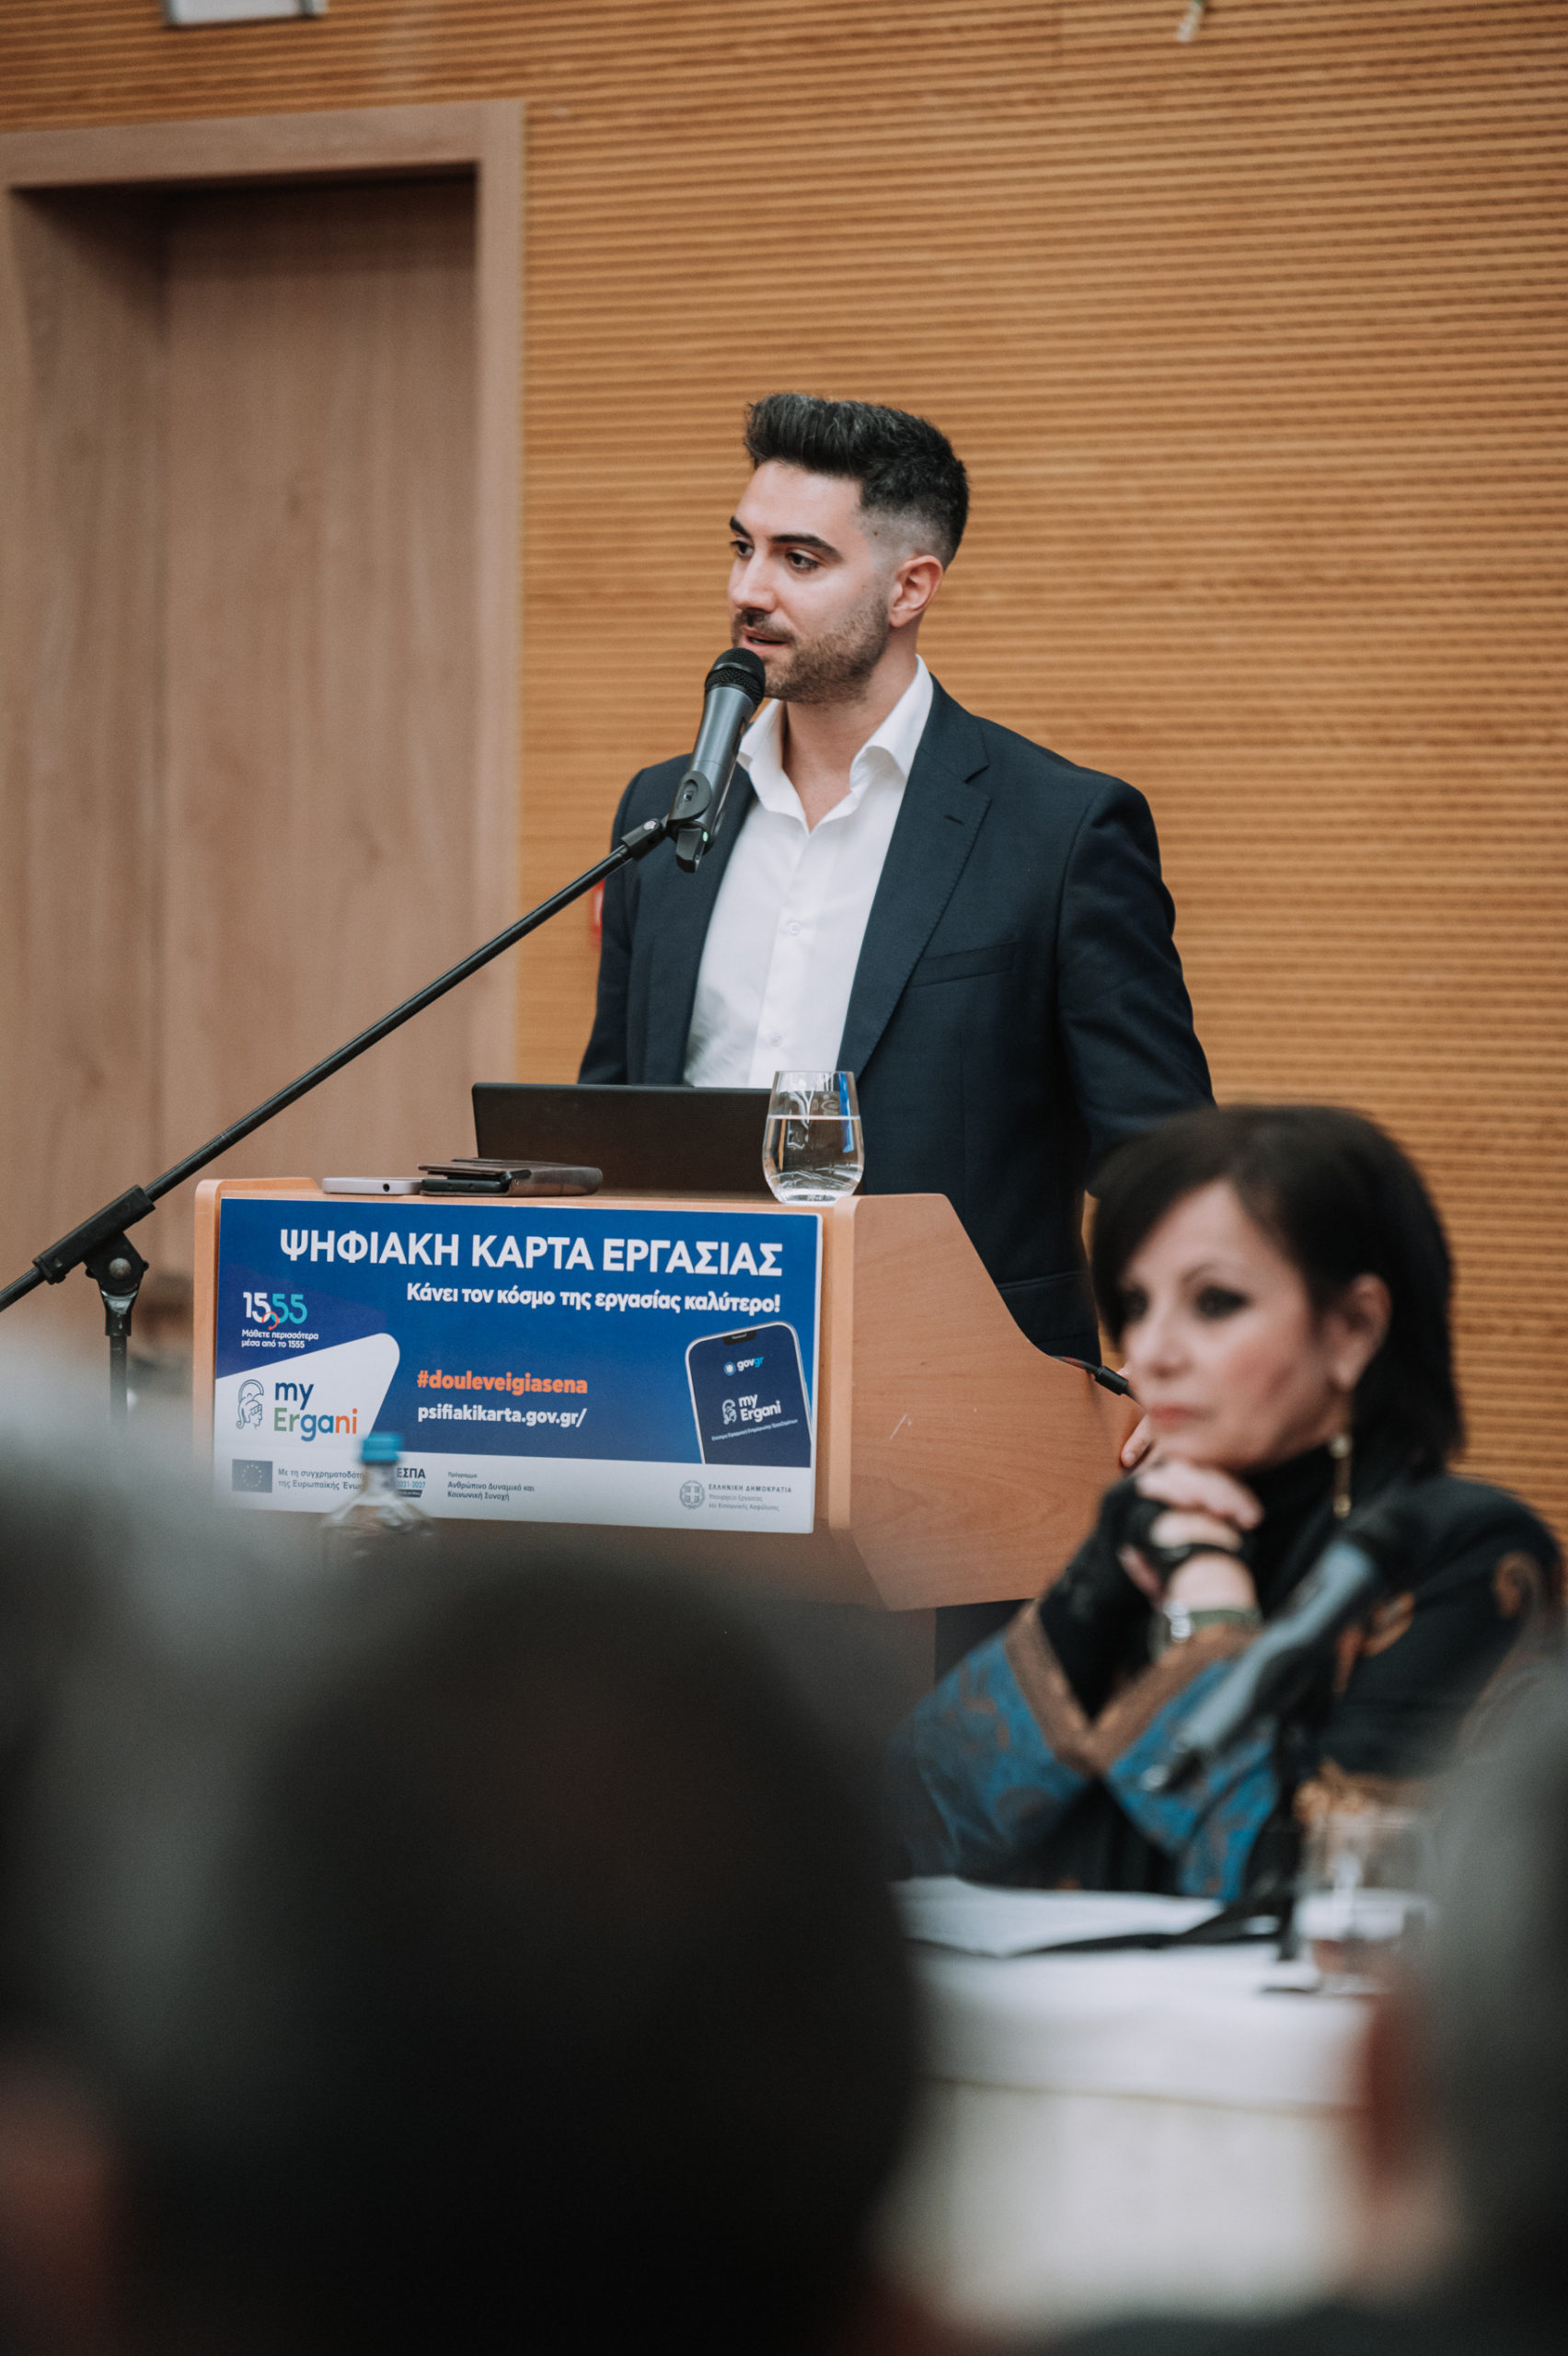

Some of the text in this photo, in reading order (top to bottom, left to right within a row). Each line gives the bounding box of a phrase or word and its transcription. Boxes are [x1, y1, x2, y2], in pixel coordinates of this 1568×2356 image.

[281, 1229, 782, 1276] ΨΗΦΙΑΚΗ ΚΑΡΤΑ ΕΡΓΑΣΙΑΣ
[243, 1292, 307, 1324] 1555
[407, 1282, 780, 1316] Κάνει τον κόσμο της εργασίας καλύτερο!
[241, 1339, 259, 1347] μέσα
[261, 1340, 276, 1348] από
[288, 1340, 306, 1349] 1555
[242, 1329, 319, 1341] Μάθετε περισσότερα
[736, 1357, 765, 1371] govgr
[417, 1369, 588, 1396] #douleveigiasena
[275, 1382, 314, 1411] my
[739, 1394, 758, 1409] my
[418, 1403, 588, 1427] psifiakikarta.gov.gr/
[739, 1400, 782, 1423] Ergani
[273, 1407, 358, 1442] Ergani
